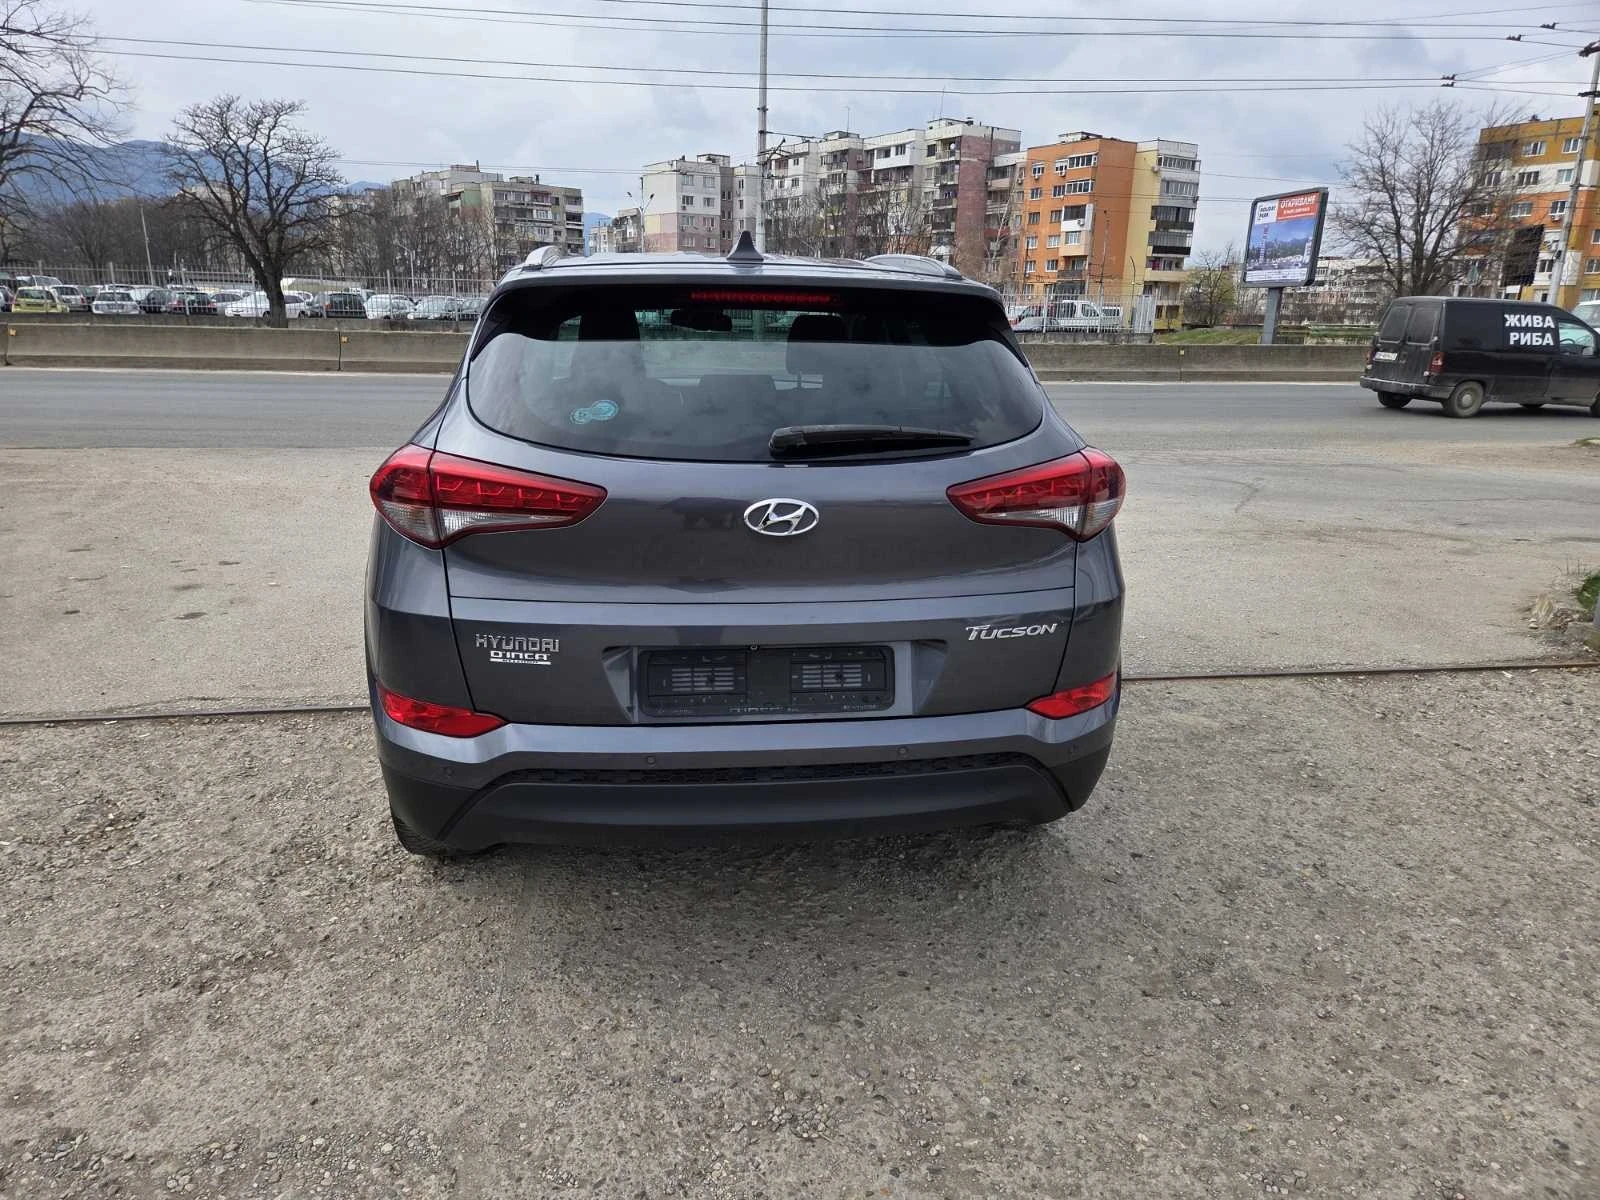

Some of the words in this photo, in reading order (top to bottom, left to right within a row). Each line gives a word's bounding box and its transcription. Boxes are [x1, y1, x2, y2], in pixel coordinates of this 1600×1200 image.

[1504, 314, 1555, 328] ЖИВА
[1509, 332, 1554, 346] РИБА
[965, 623, 1058, 641] TUCSON
[475, 633, 559, 652] HYUNDAI
